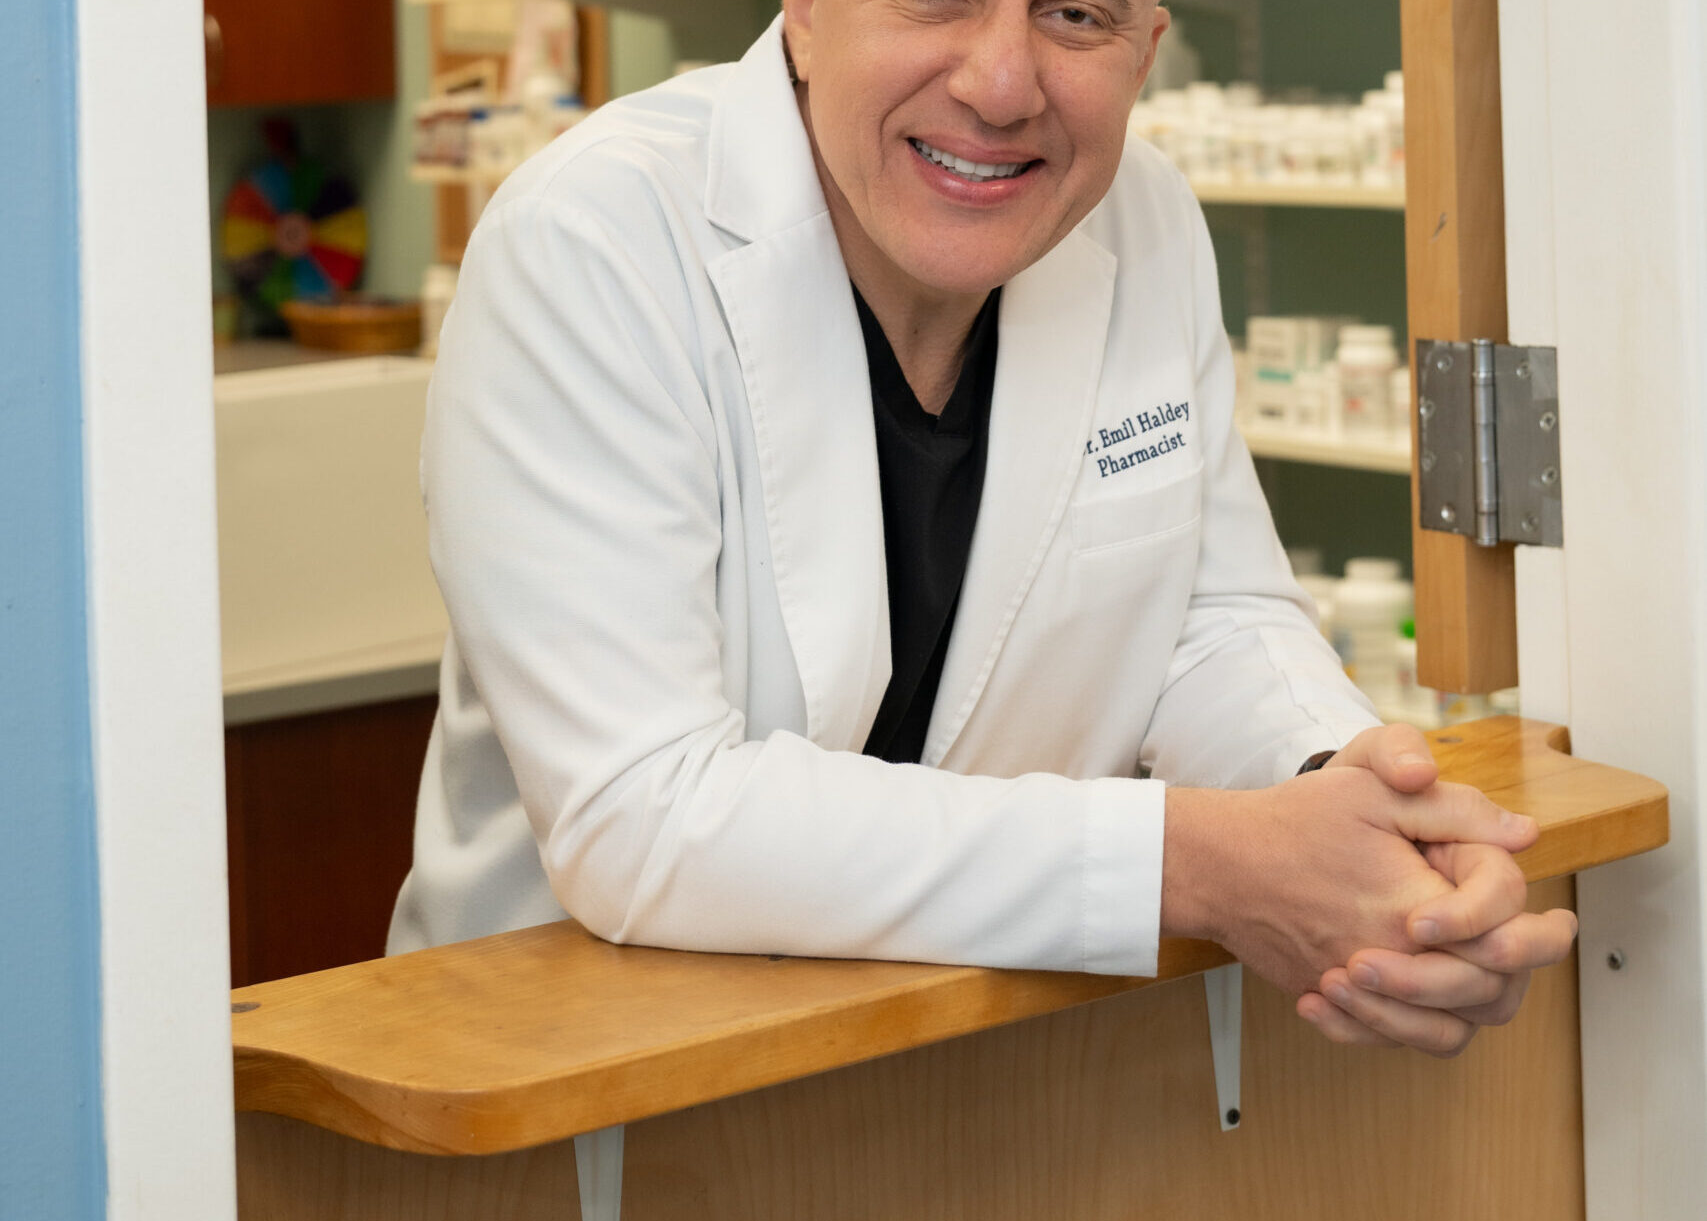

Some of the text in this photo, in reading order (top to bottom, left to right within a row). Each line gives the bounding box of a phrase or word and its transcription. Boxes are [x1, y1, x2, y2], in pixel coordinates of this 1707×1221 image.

[1084, 401, 1189, 455] r. Emil Haldey
[1097, 431, 1186, 478] Pharmacist
